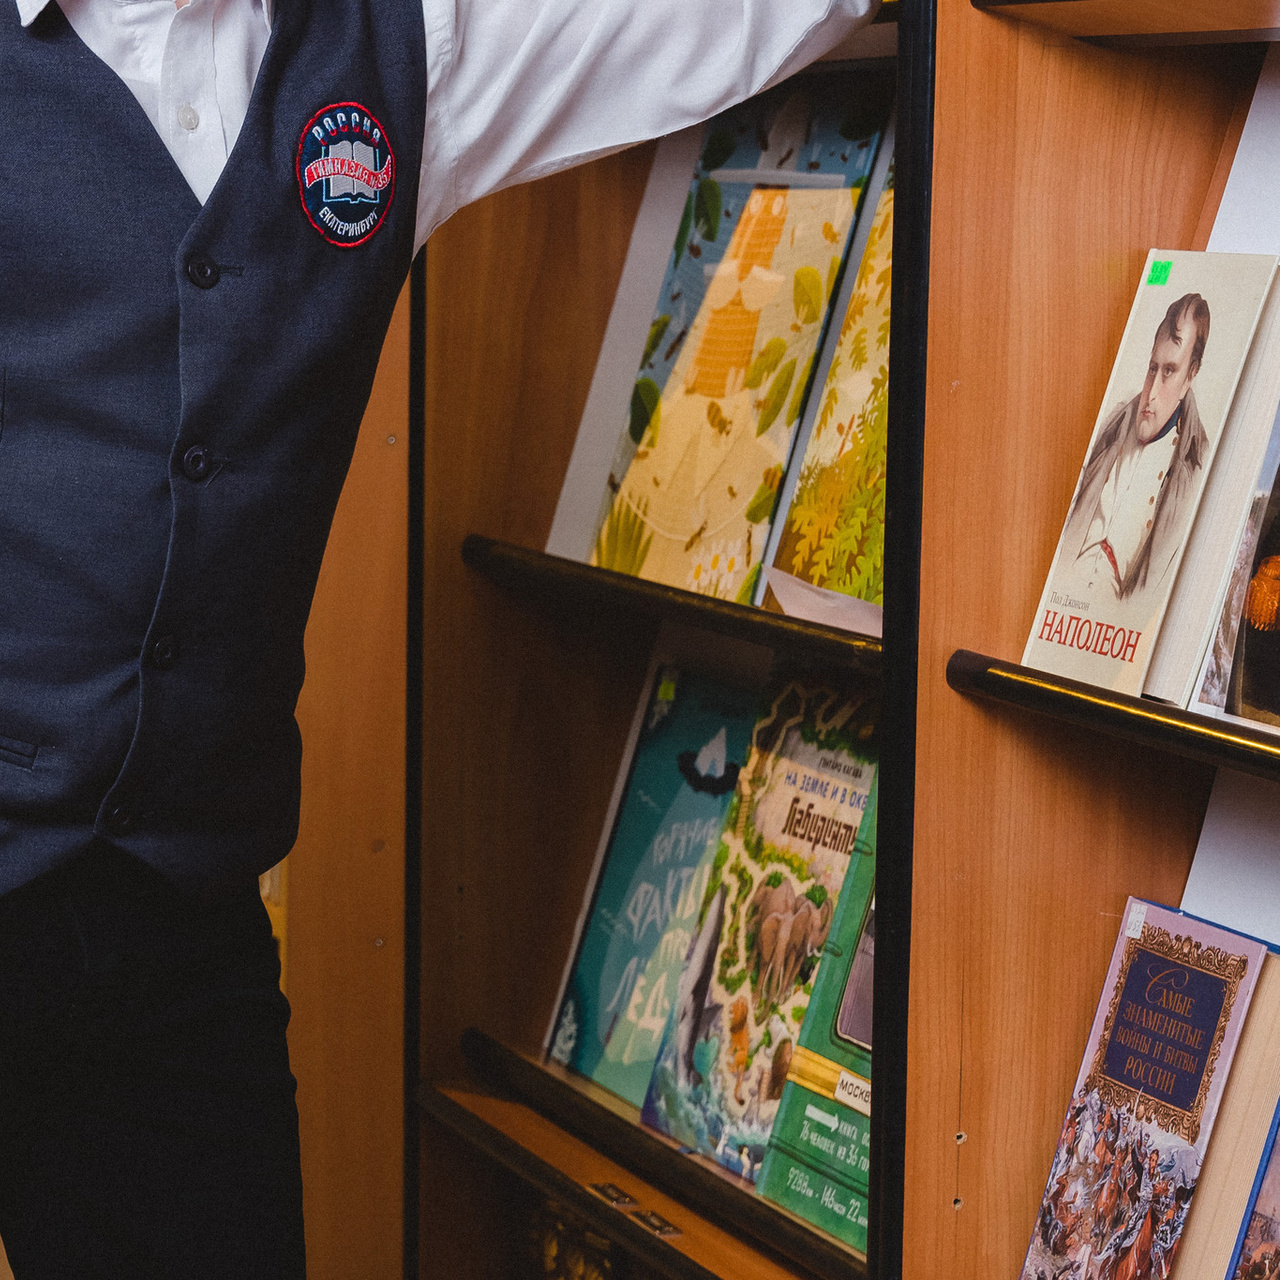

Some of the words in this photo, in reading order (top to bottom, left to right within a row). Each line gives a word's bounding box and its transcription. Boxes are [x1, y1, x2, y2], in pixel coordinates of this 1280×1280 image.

[311, 112, 381, 148] РОССИЯ
[310, 159, 368, 183] ГИМНАЗИЯ
[319, 206, 378, 237] ЕКАТЕРИНБУРГ
[1050, 591, 1062, 604] Пол
[1062, 595, 1091, 611] Джонсон
[1038, 609, 1142, 663] НАПОЛЕОН
[784, 771, 798, 786] НА
[799, 774, 830, 798] ЗЕМЛЕ
[830, 785, 839, 801] И
[839, 788, 848, 804] В
[626, 863, 712, 944] ФАКТЫ
[659, 927, 692, 967] ПРО
[1122, 1000, 1206, 1051] ЗНАМЕНИТЫЕ
[1115, 1025, 1152, 1056] ВОЙНЫ
[1152, 1041, 1163, 1058] И
[1163, 1046, 1199, 1074] БИТВЫ
[840, 1079, 870, 1104] МОСКВ
[1123, 1055, 1177, 1095] РОССИИ
[800, 1120, 811, 1141] 76
[836, 1145, 847, 1161] ИЗ
[846, 1143, 859, 1166] 36
